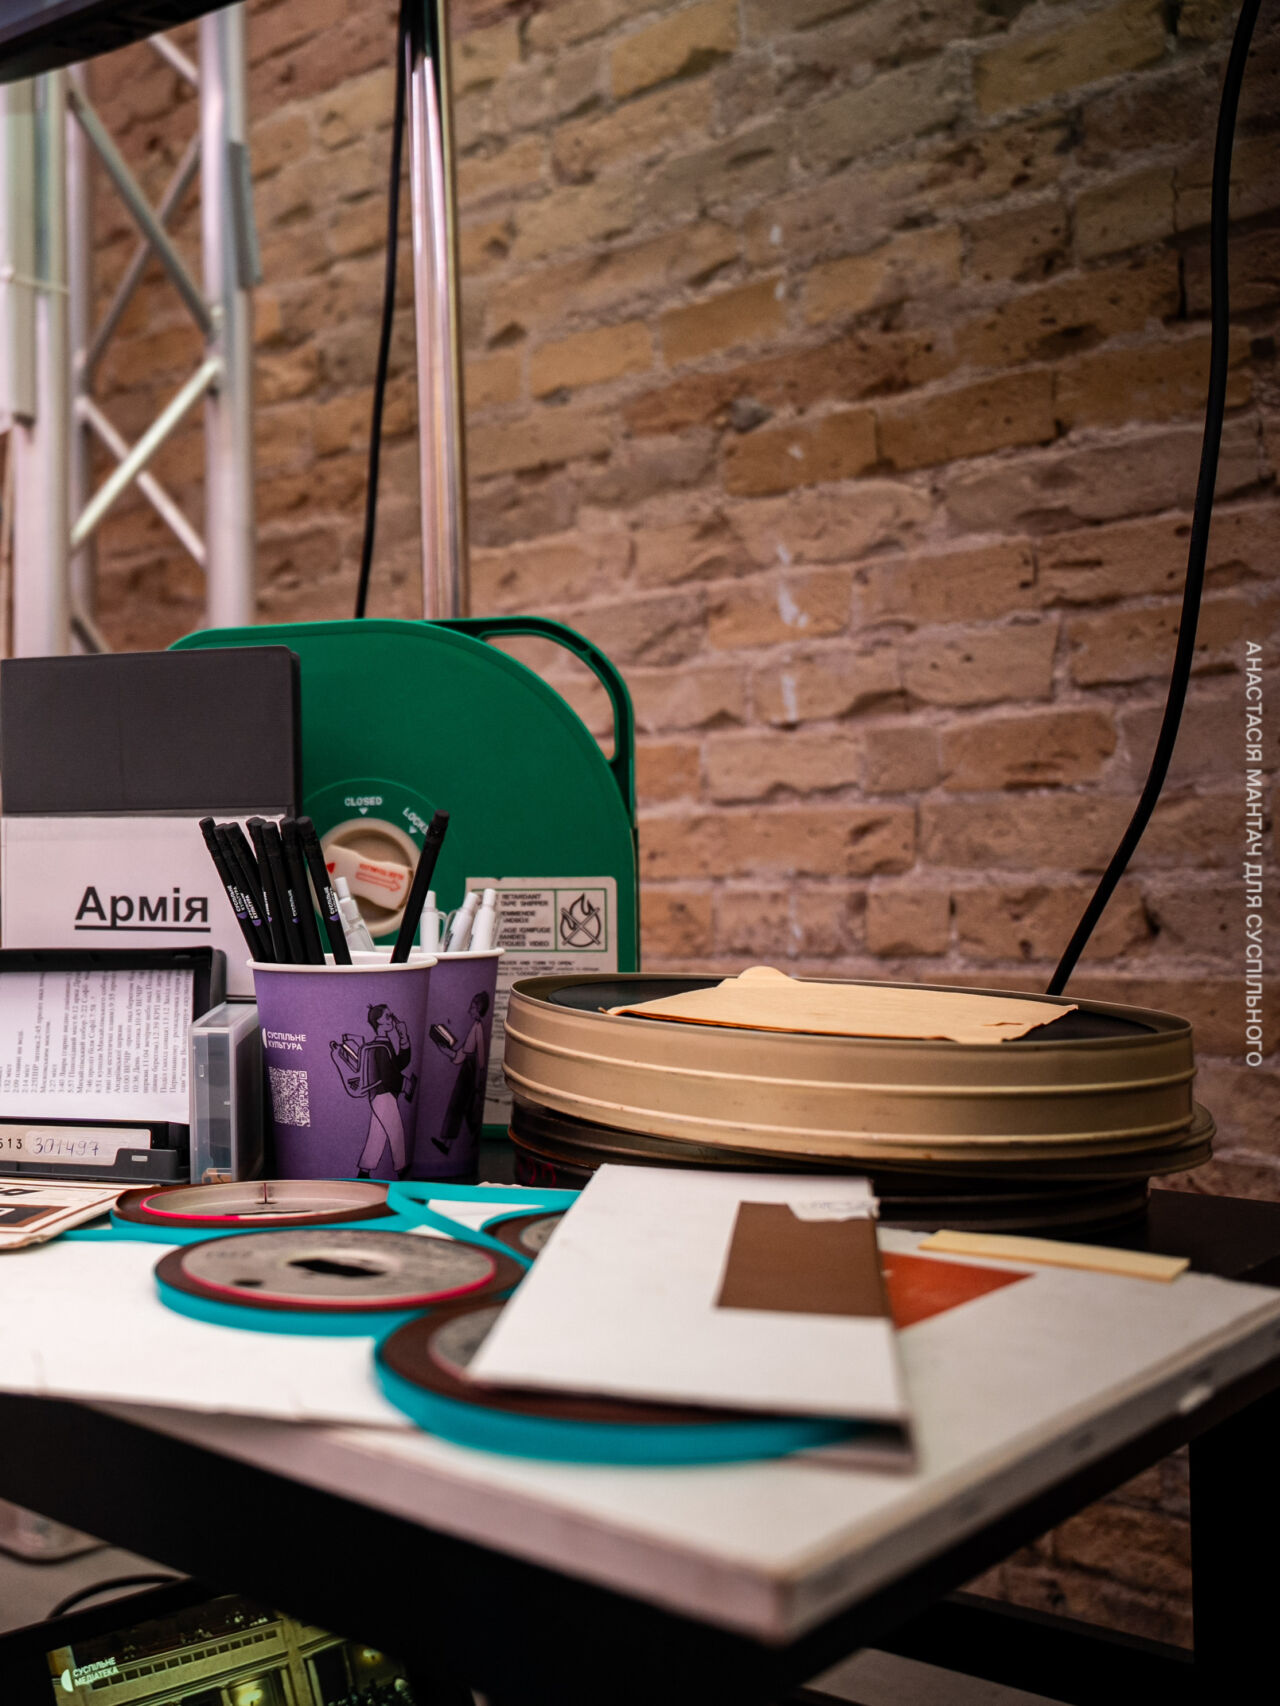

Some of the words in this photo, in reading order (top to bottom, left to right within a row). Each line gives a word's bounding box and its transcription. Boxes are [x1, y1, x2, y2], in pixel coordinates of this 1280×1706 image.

[344, 797, 382, 806] CLOSED
[75, 886, 208, 927] Армія
[267, 1031, 307, 1042] СУСПІЛЬНЕ
[268, 1040, 303, 1051] КУЛЬТУРА
[31, 1137, 100, 1157] 301497
[73, 1656, 116, 1677] СУСПІЛЬНЕ
[74, 1666, 119, 1686] МЕДІАТЕКА
